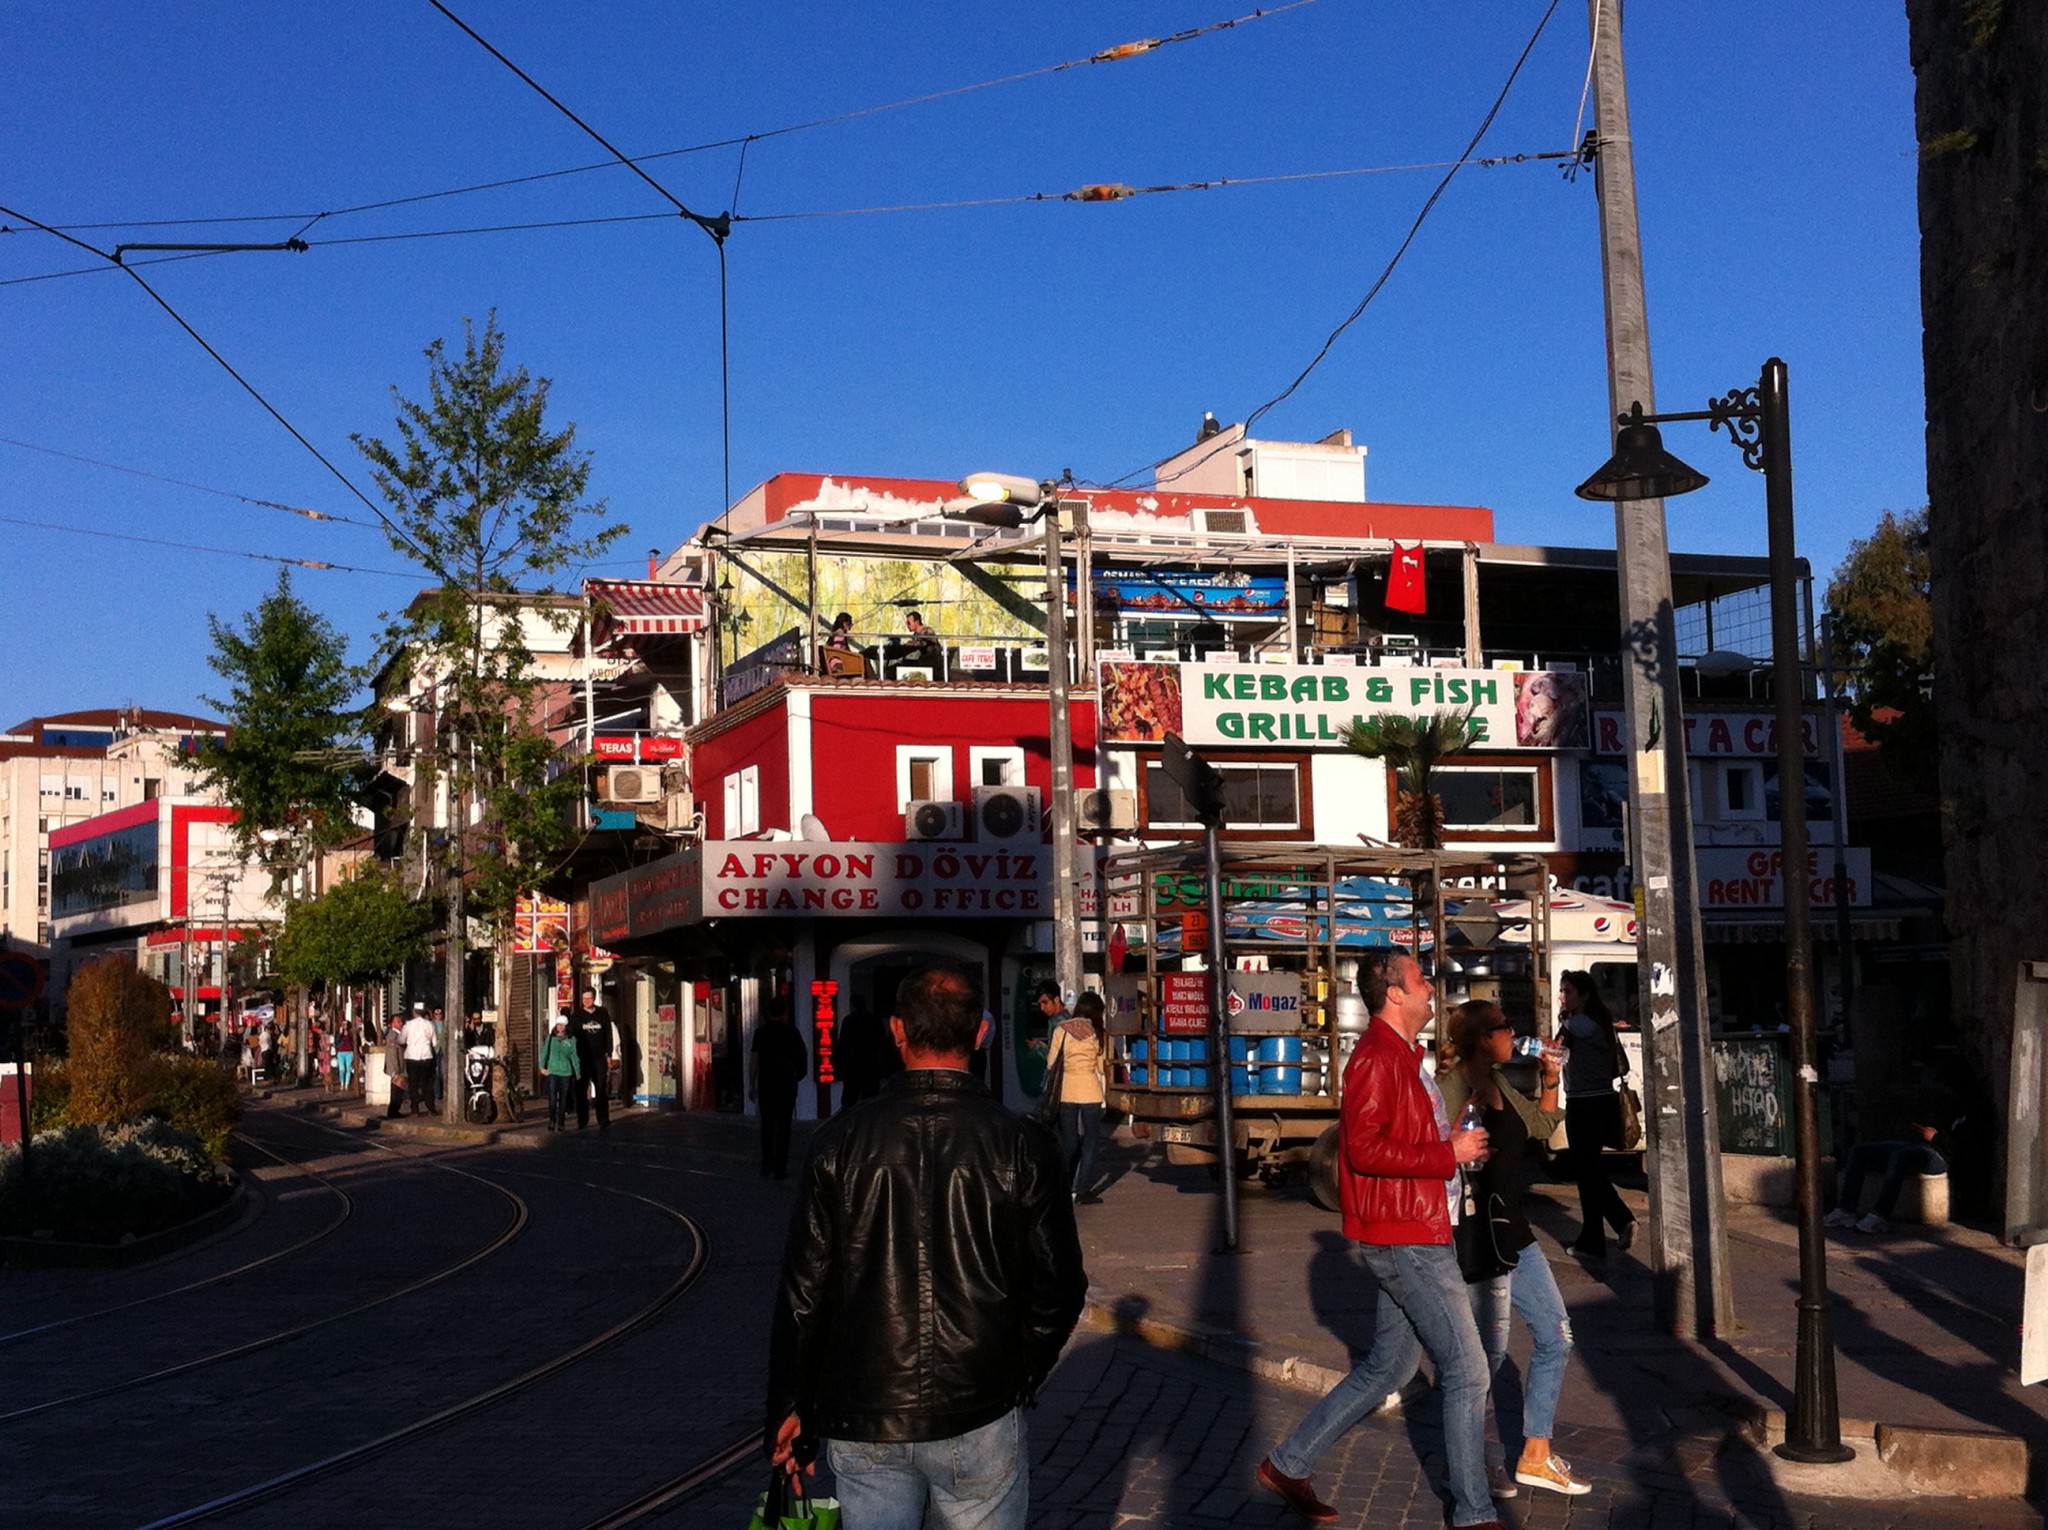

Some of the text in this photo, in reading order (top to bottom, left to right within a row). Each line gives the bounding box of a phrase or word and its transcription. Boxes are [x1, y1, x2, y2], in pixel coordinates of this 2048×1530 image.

[1204, 673, 1350, 703] KEBAB
[1366, 677, 1393, 702] &
[1216, 712, 1490, 742] GRILL HSE
[1599, 718, 1696, 753] RT
[1709, 719, 1732, 752] A
[600, 743, 633, 754] TERAS
[717, 848, 1038, 880] AFYON DÖVİZ
[1747, 852, 1818, 877] GAE
[1572, 866, 1632, 900] caf
[1708, 879, 1774, 904] RENT
[718, 888, 1039, 910] CHANGE OFFICE
[1249, 993, 1297, 1012] Mogaz
